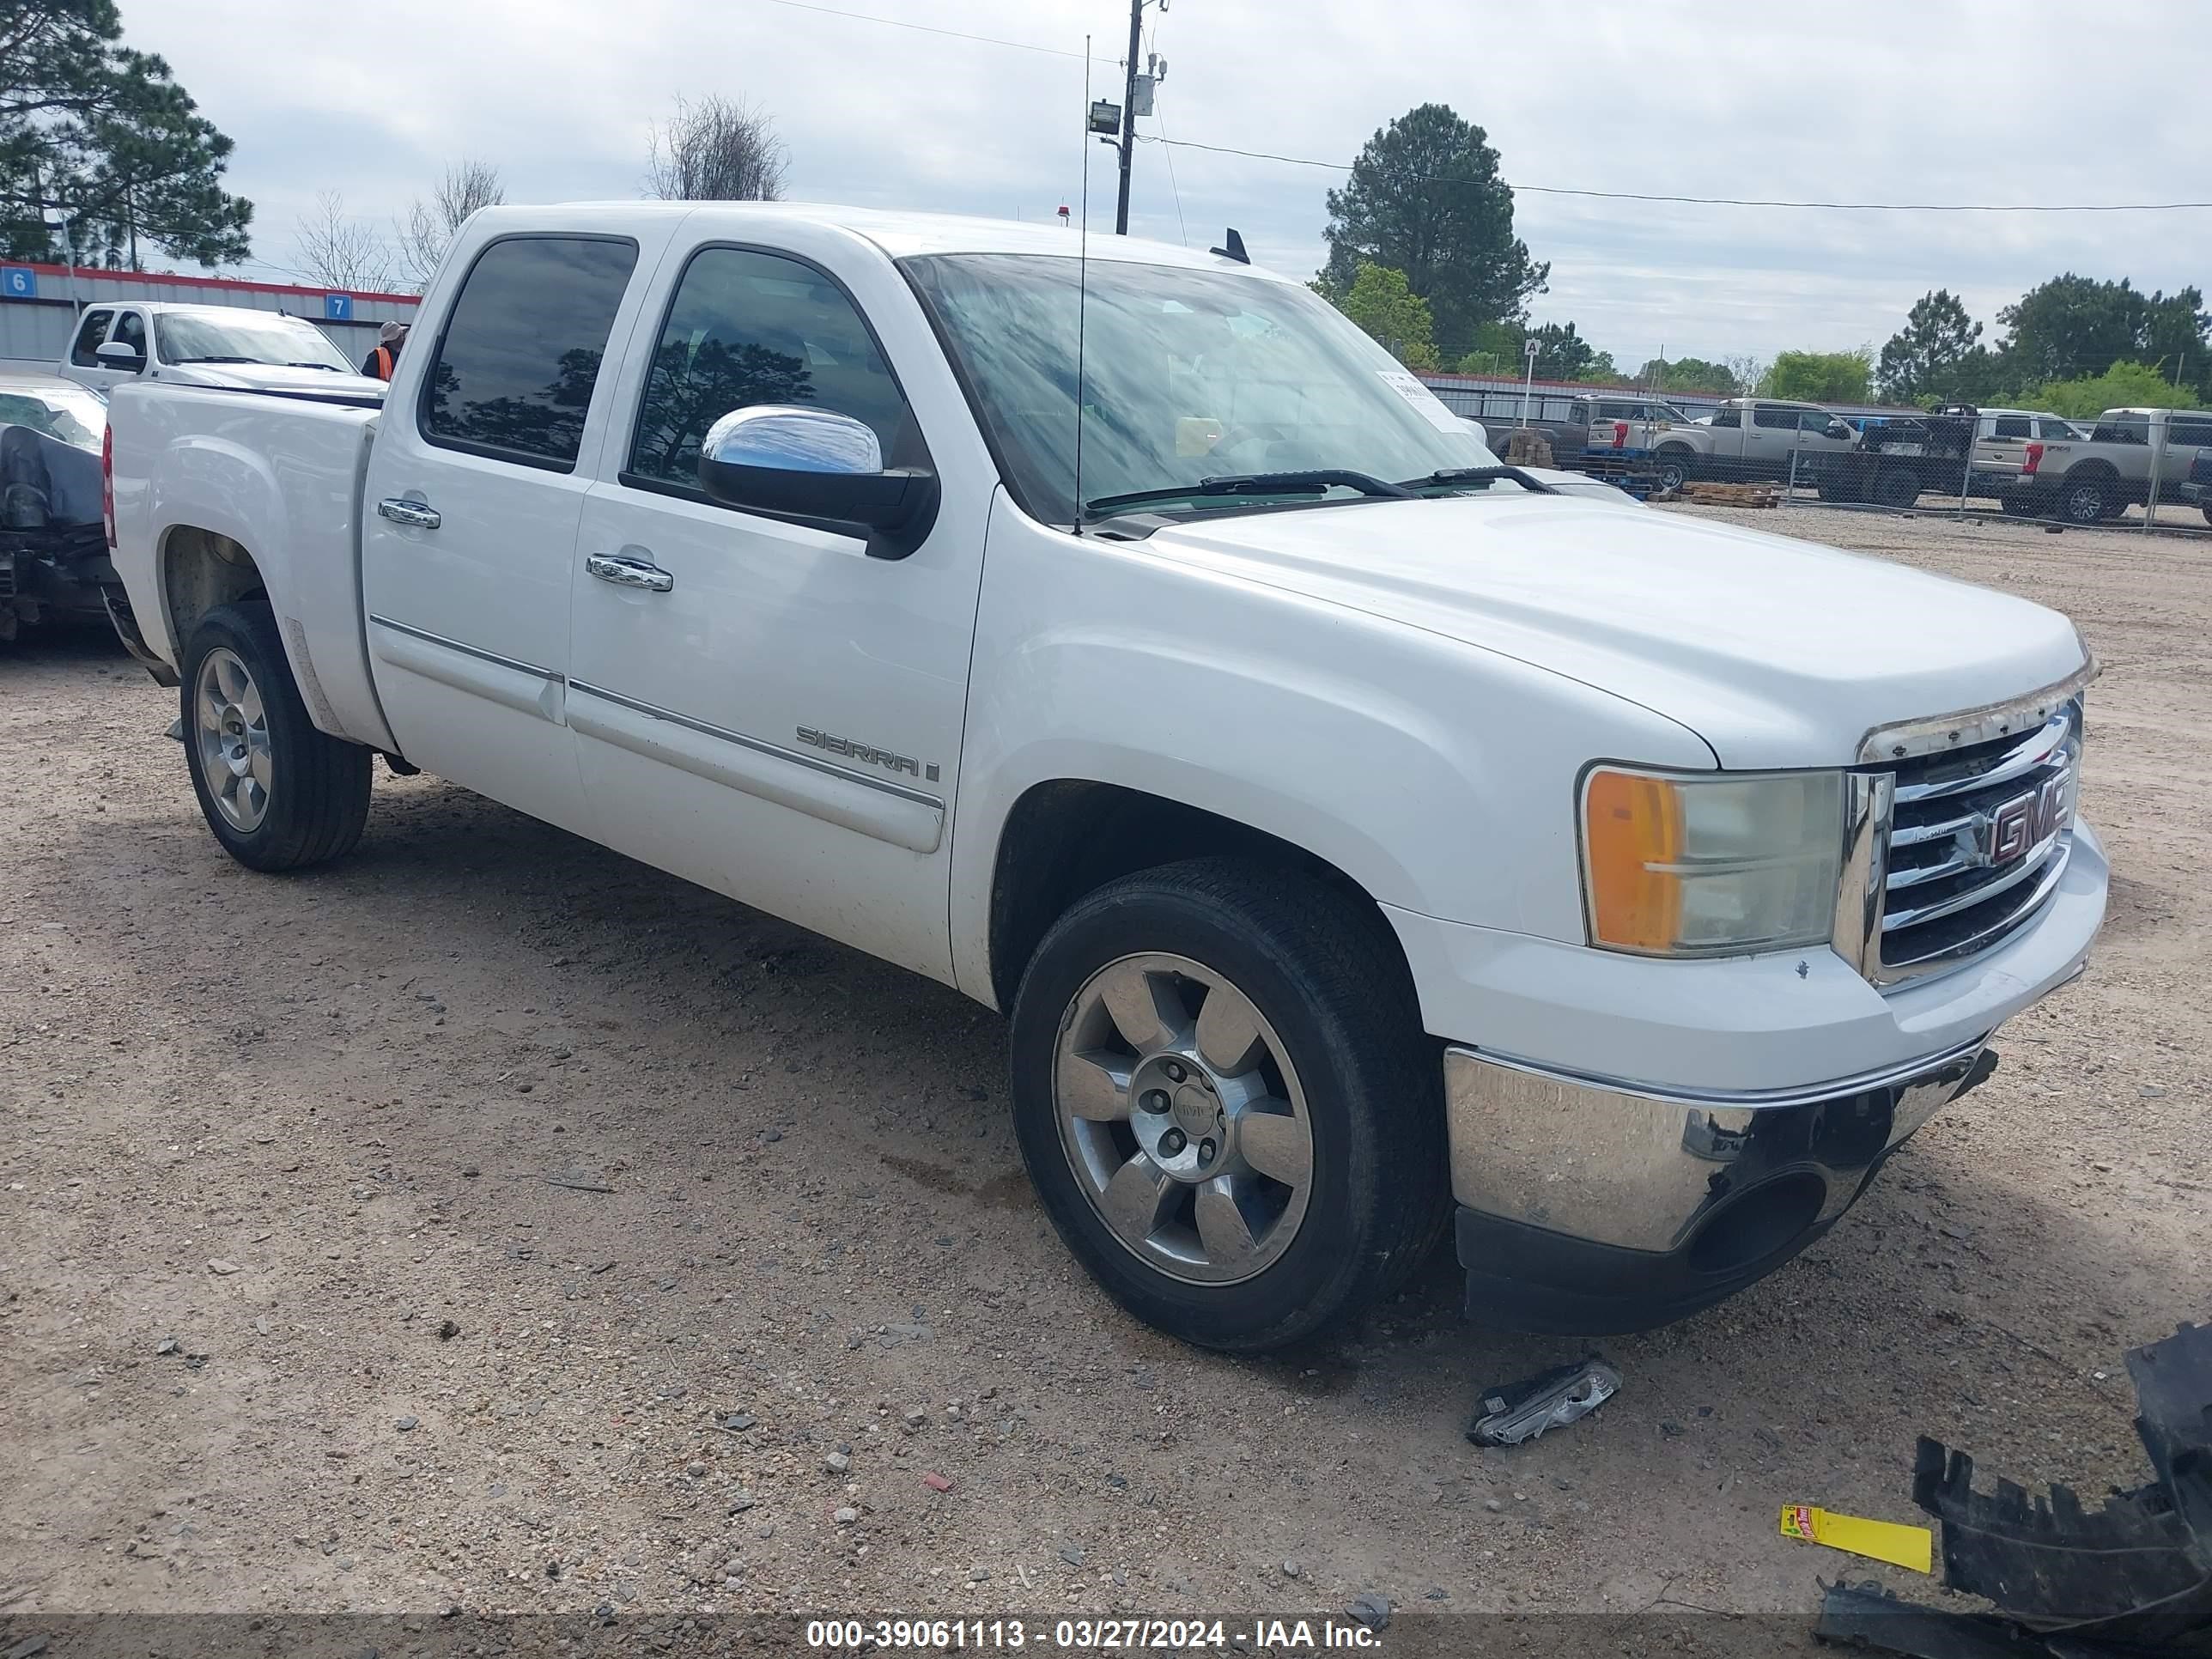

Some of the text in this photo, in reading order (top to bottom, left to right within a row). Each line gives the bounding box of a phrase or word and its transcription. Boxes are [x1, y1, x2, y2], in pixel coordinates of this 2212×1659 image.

[13, 273, 26, 291] 6
[334, 299, 344, 315] 7
[1528, 343, 1537, 352] A
[796, 723, 919, 778] SIERRA
[1990, 767, 2071, 863] GMC
